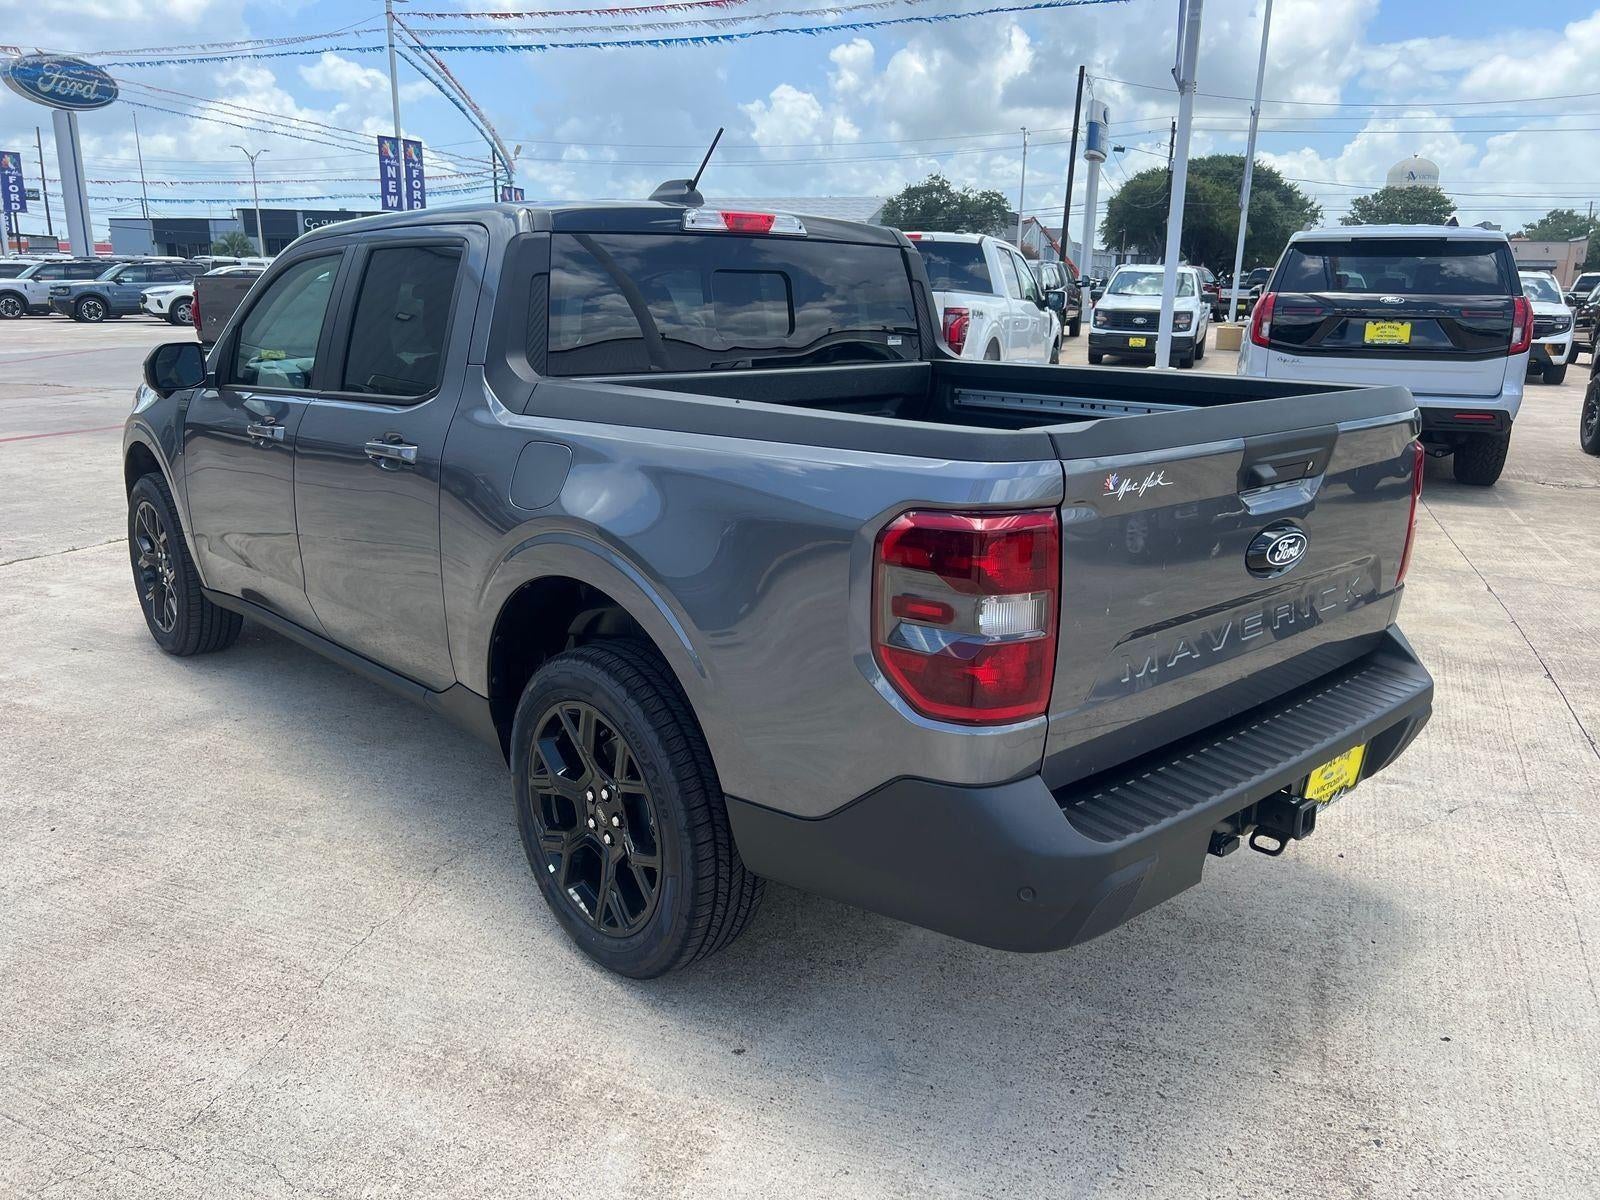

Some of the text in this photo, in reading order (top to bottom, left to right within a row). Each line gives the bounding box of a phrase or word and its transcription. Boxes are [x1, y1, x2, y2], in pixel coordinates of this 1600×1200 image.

[37, 63, 99, 100] Ford
[8, 175, 21, 211] FORD
[386, 165, 398, 208] NEW
[412, 169, 422, 210] FORD
[1274, 537, 1301, 562] Ford
[1120, 576, 1362, 684] MAVERICK
